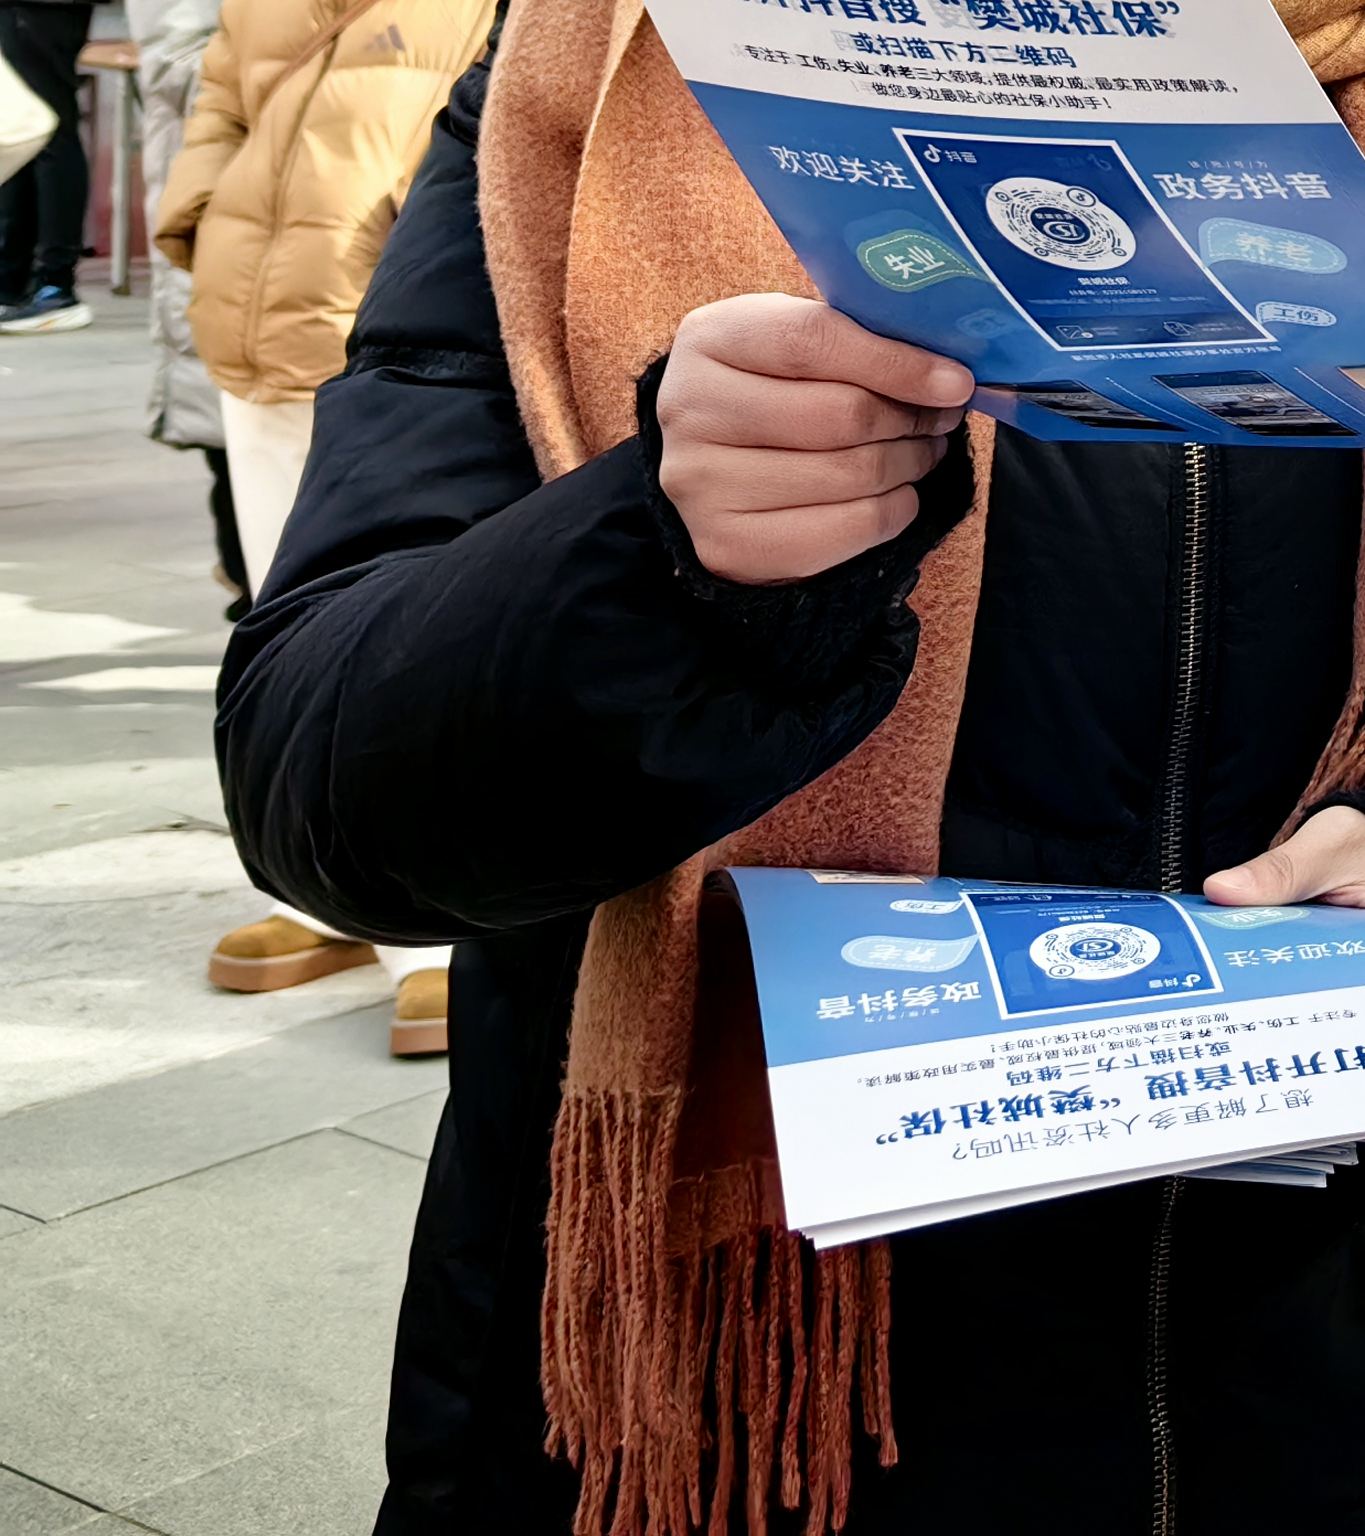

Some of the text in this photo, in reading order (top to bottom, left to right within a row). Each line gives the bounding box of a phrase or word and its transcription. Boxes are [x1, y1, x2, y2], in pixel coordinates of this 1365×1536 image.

[852, 33, 1077, 69] 或扫描下方二维码
[768, 145, 916, 190] 欢迎关注
[1153, 171, 1333, 200] 政务抖音
[883, 245, 946, 280] 失业
[816, 980, 983, 1020] 政务抖音
[1005, 1041, 1233, 1087] 或扫描下方二维码
